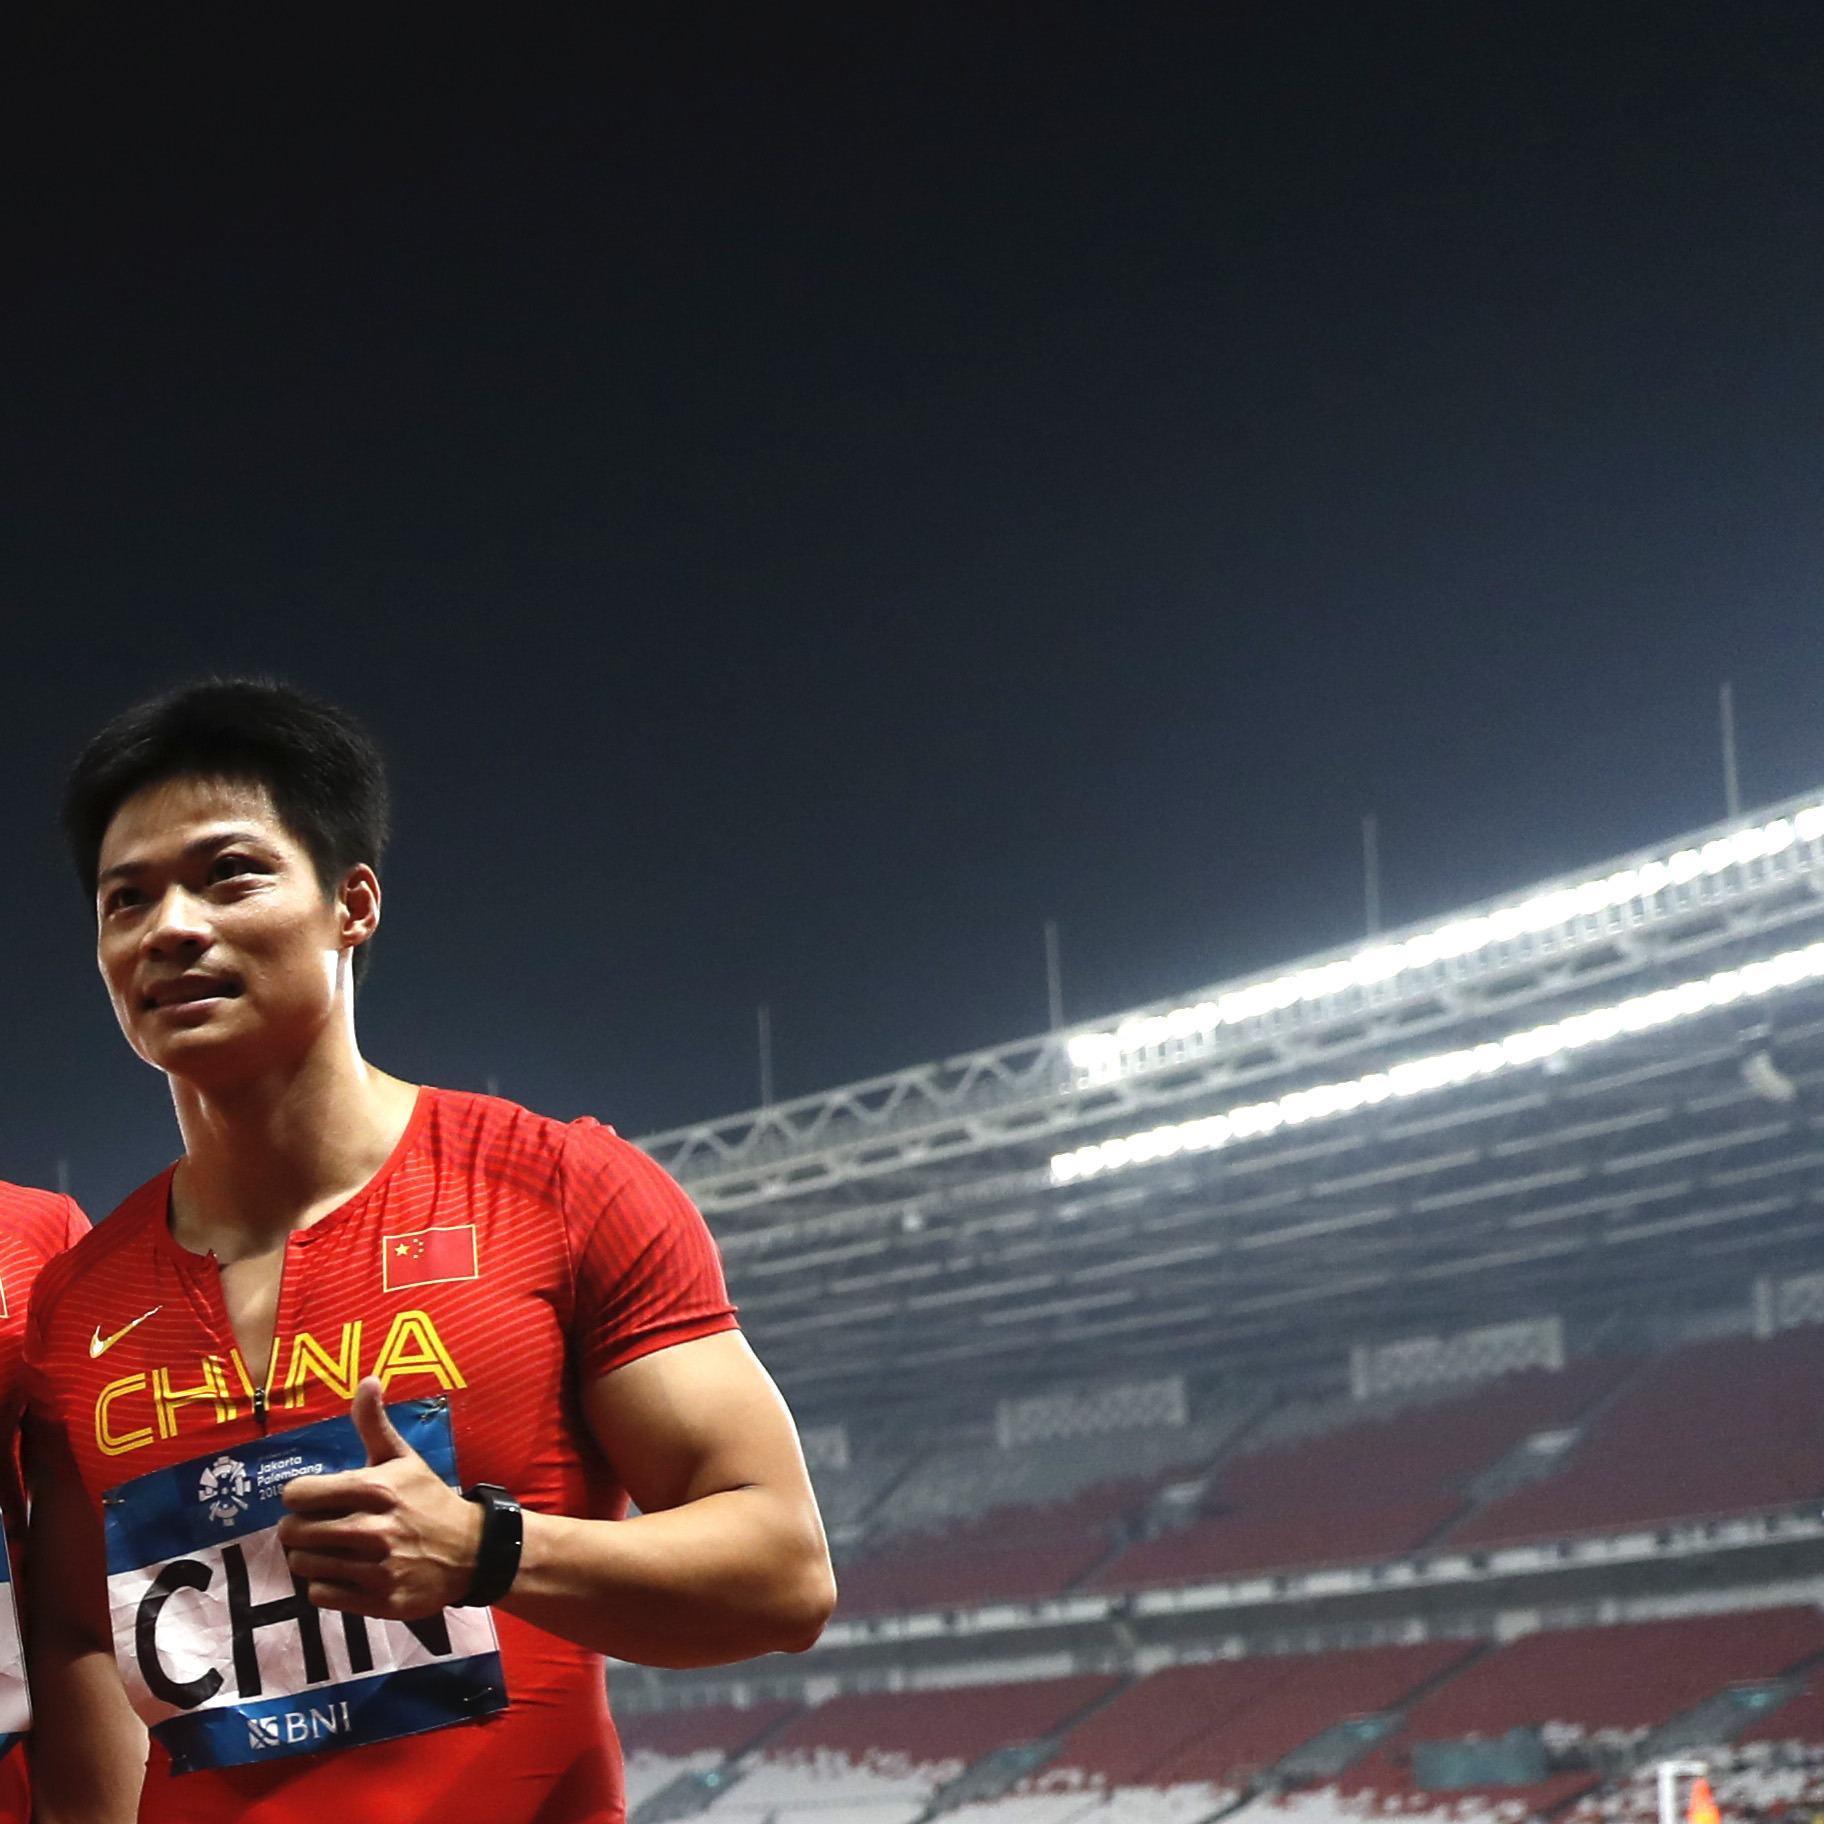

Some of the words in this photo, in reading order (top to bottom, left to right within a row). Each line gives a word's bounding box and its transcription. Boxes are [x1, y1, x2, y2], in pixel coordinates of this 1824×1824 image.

[95, 1310, 467, 1456] CHINA
[257, 1456, 303, 1475] Jakarta
[257, 1463, 323, 1486] Palembang
[284, 1702, 352, 1745] BNI
